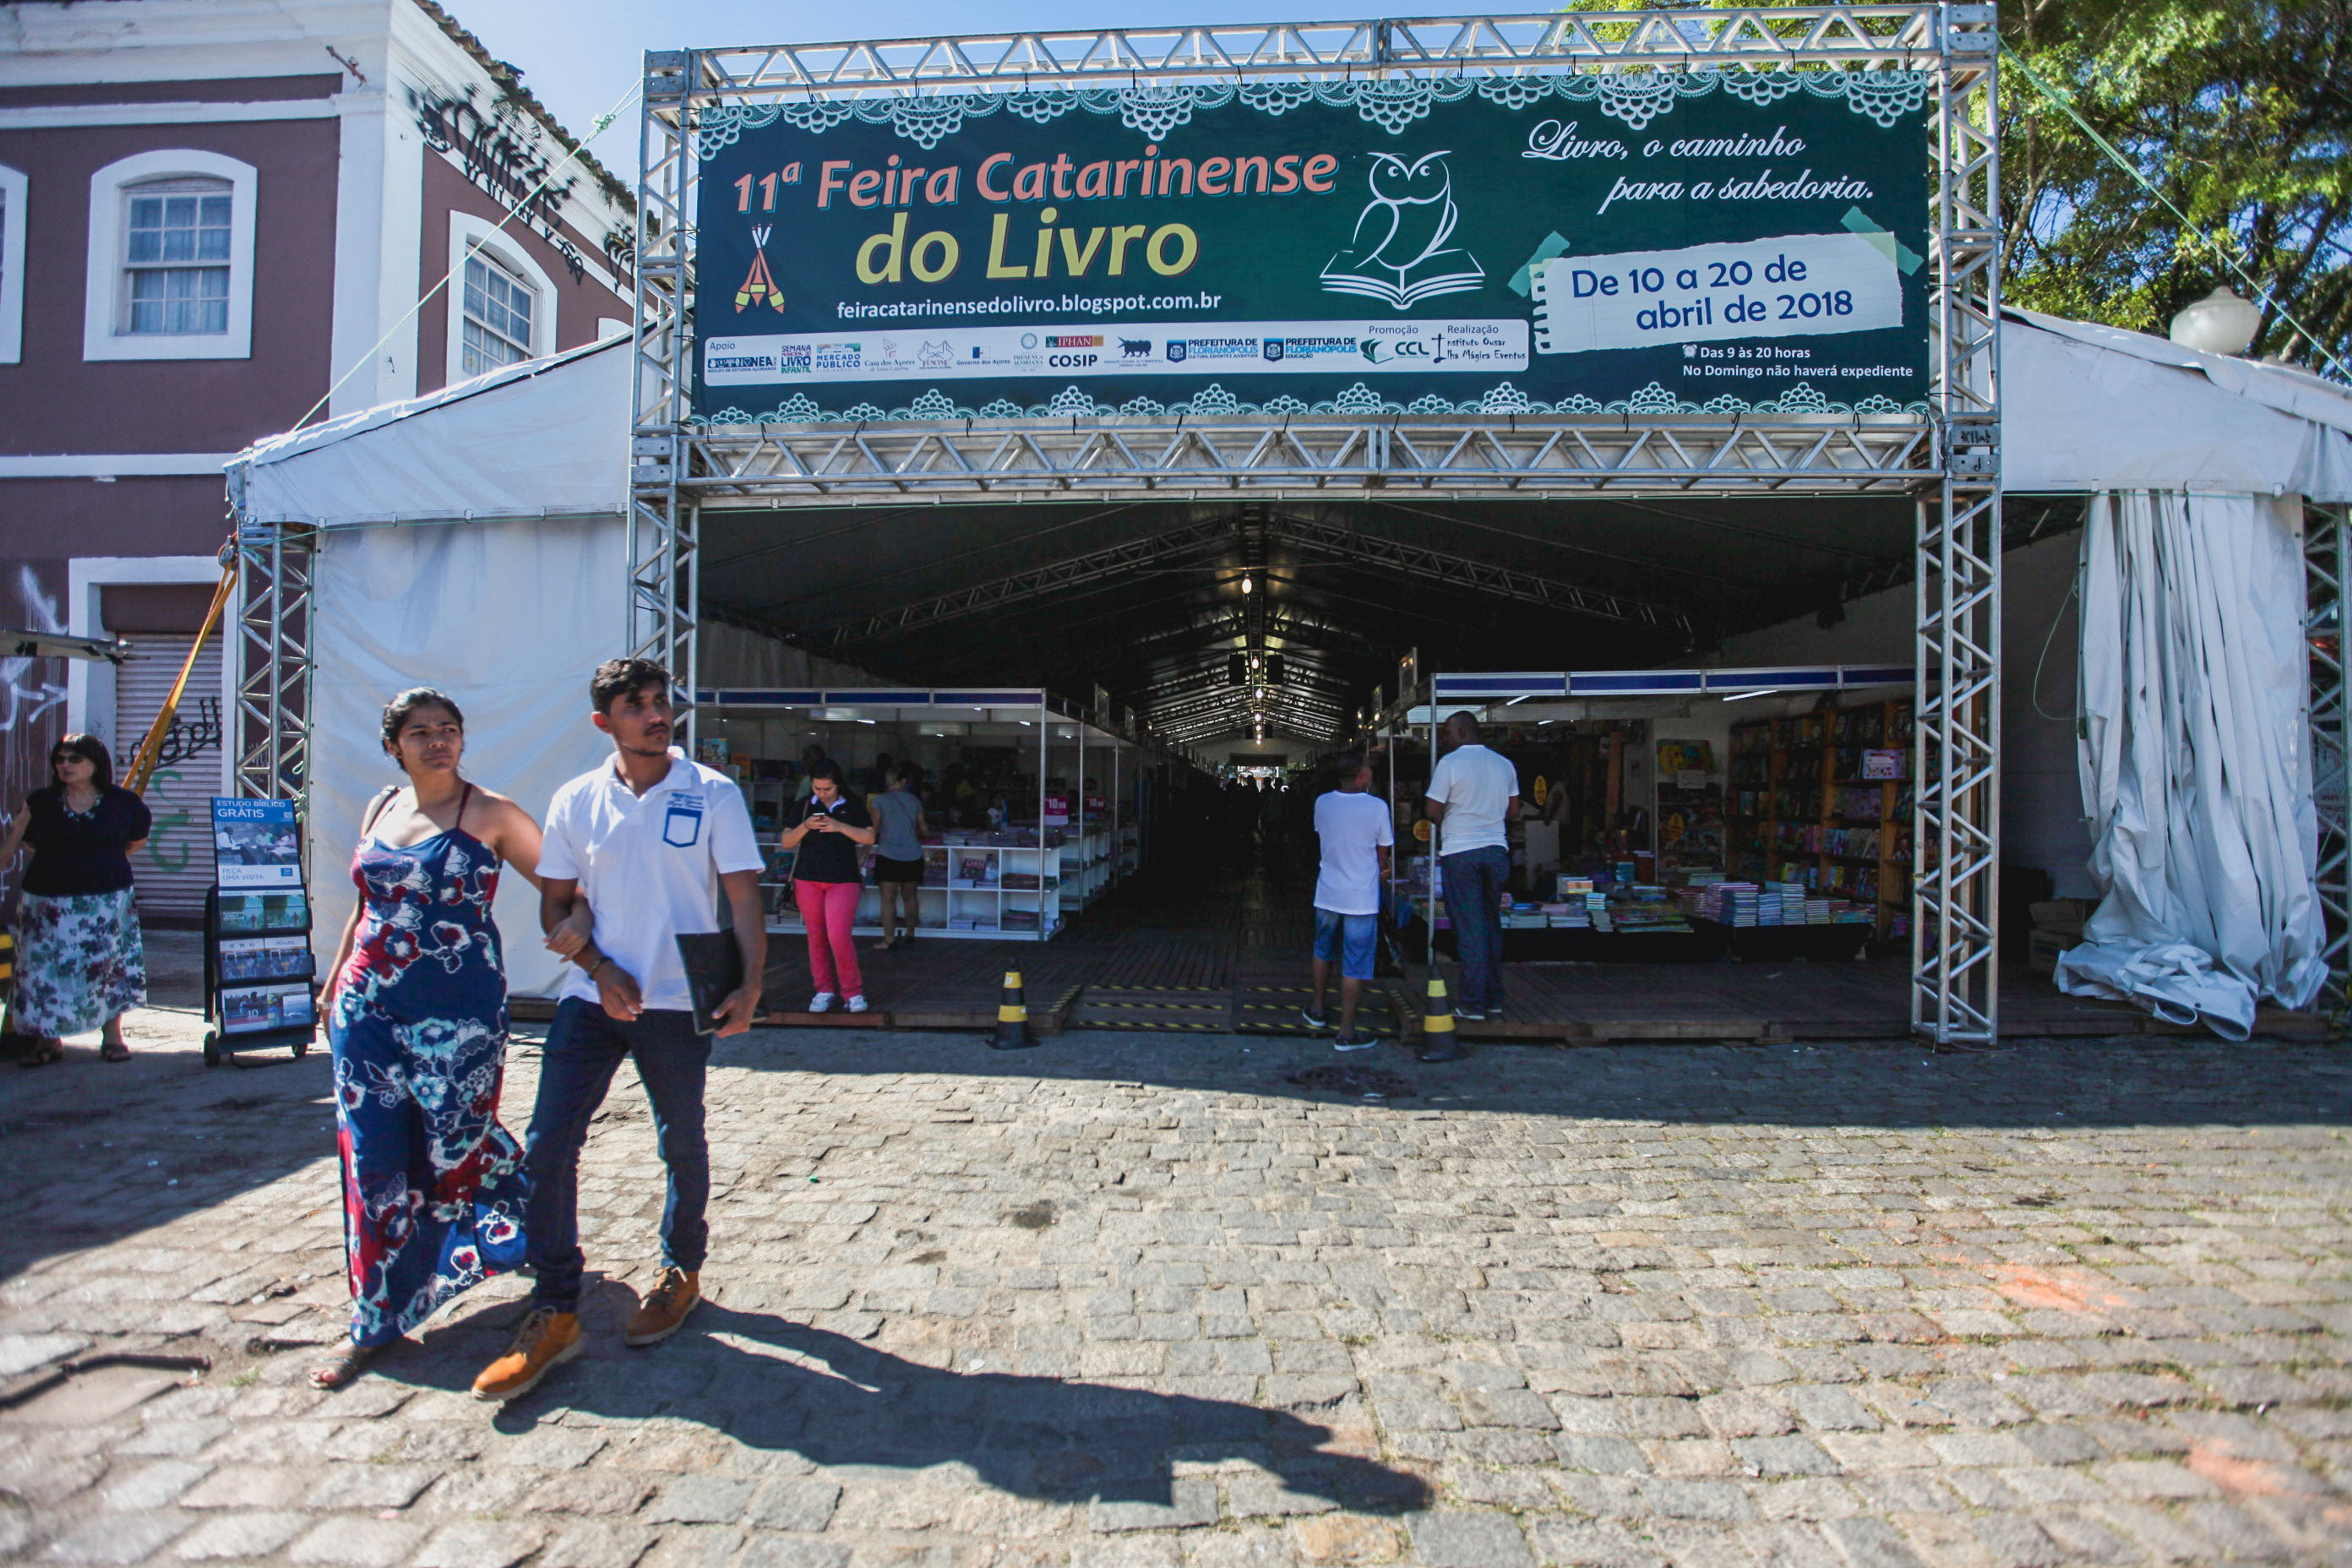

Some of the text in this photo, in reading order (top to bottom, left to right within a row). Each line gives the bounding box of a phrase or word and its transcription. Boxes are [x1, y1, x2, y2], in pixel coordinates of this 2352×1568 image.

[1521, 119, 1806, 161] Livro, o caminho
[817, 154, 961, 210] Feira
[976, 144, 1338, 203] Catarinense
[1596, 169, 1874, 215] para a sabedoria.
[856, 206, 1200, 286] do Livro
[1571, 253, 1807, 298] De 10 a 20 de
[836, 291, 1222, 318] feiracatarinensedolivro.blogspot.com.br
[1636, 290, 1854, 330] abril de 2018
[1369, 325, 1418, 335] Promoção
[1447, 324, 1499, 335] Realização
[709, 341, 736, 351] Apoio
[1058, 337, 1092, 346] IPHAN
[1395, 341, 1430, 355] CCL
[1494, 349, 1526, 360] Eventos
[1701, 346, 1810, 358] Das 9 às 20 horas
[752, 357, 772, 367] NEA
[781, 356, 811, 367] LIVRO
[1048, 354, 1097, 368] COSIP
[781, 366, 812, 374] INFANTIL
[1683, 364, 1914, 378] No Domingo não haverá expediente
[217, 807, 264, 819] GRÁTIS
